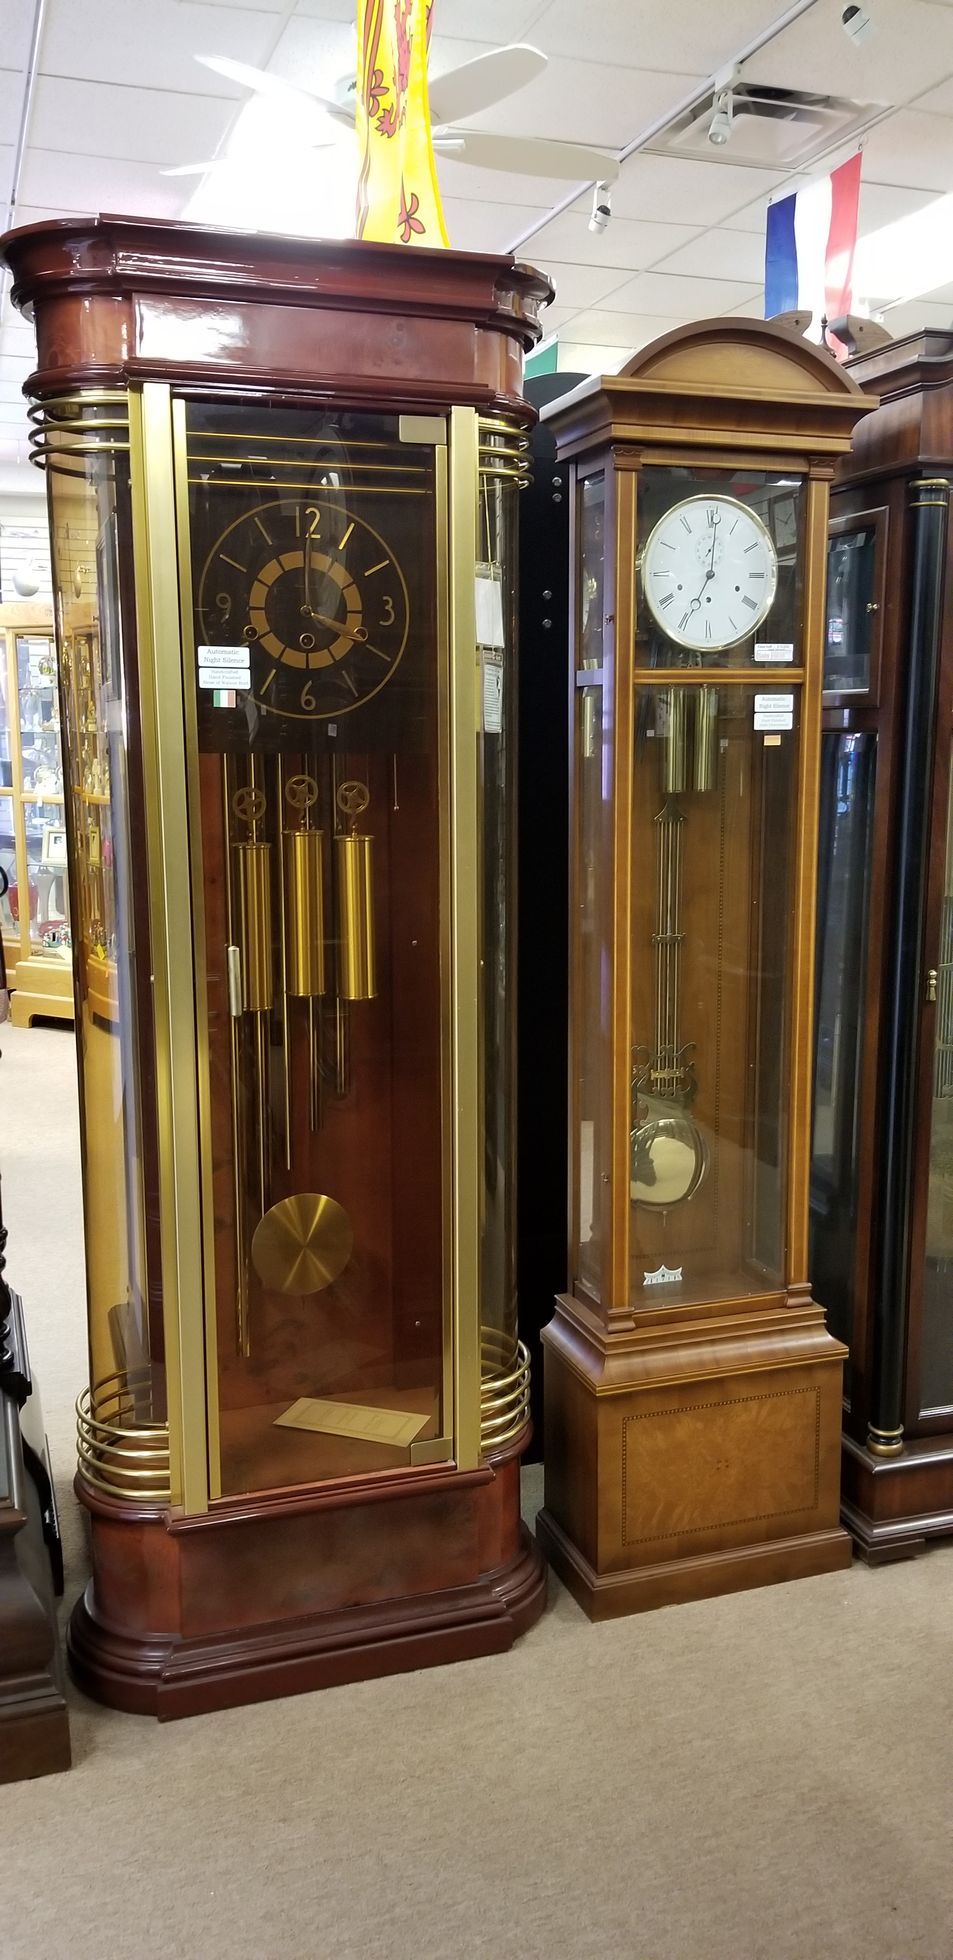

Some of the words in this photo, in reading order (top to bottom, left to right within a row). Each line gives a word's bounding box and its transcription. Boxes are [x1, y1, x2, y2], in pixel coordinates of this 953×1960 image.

[296, 506, 321, 539] 12
[215, 593, 232, 623] 9
[379, 596, 395, 626] 3
[301, 681, 316, 710] 6
